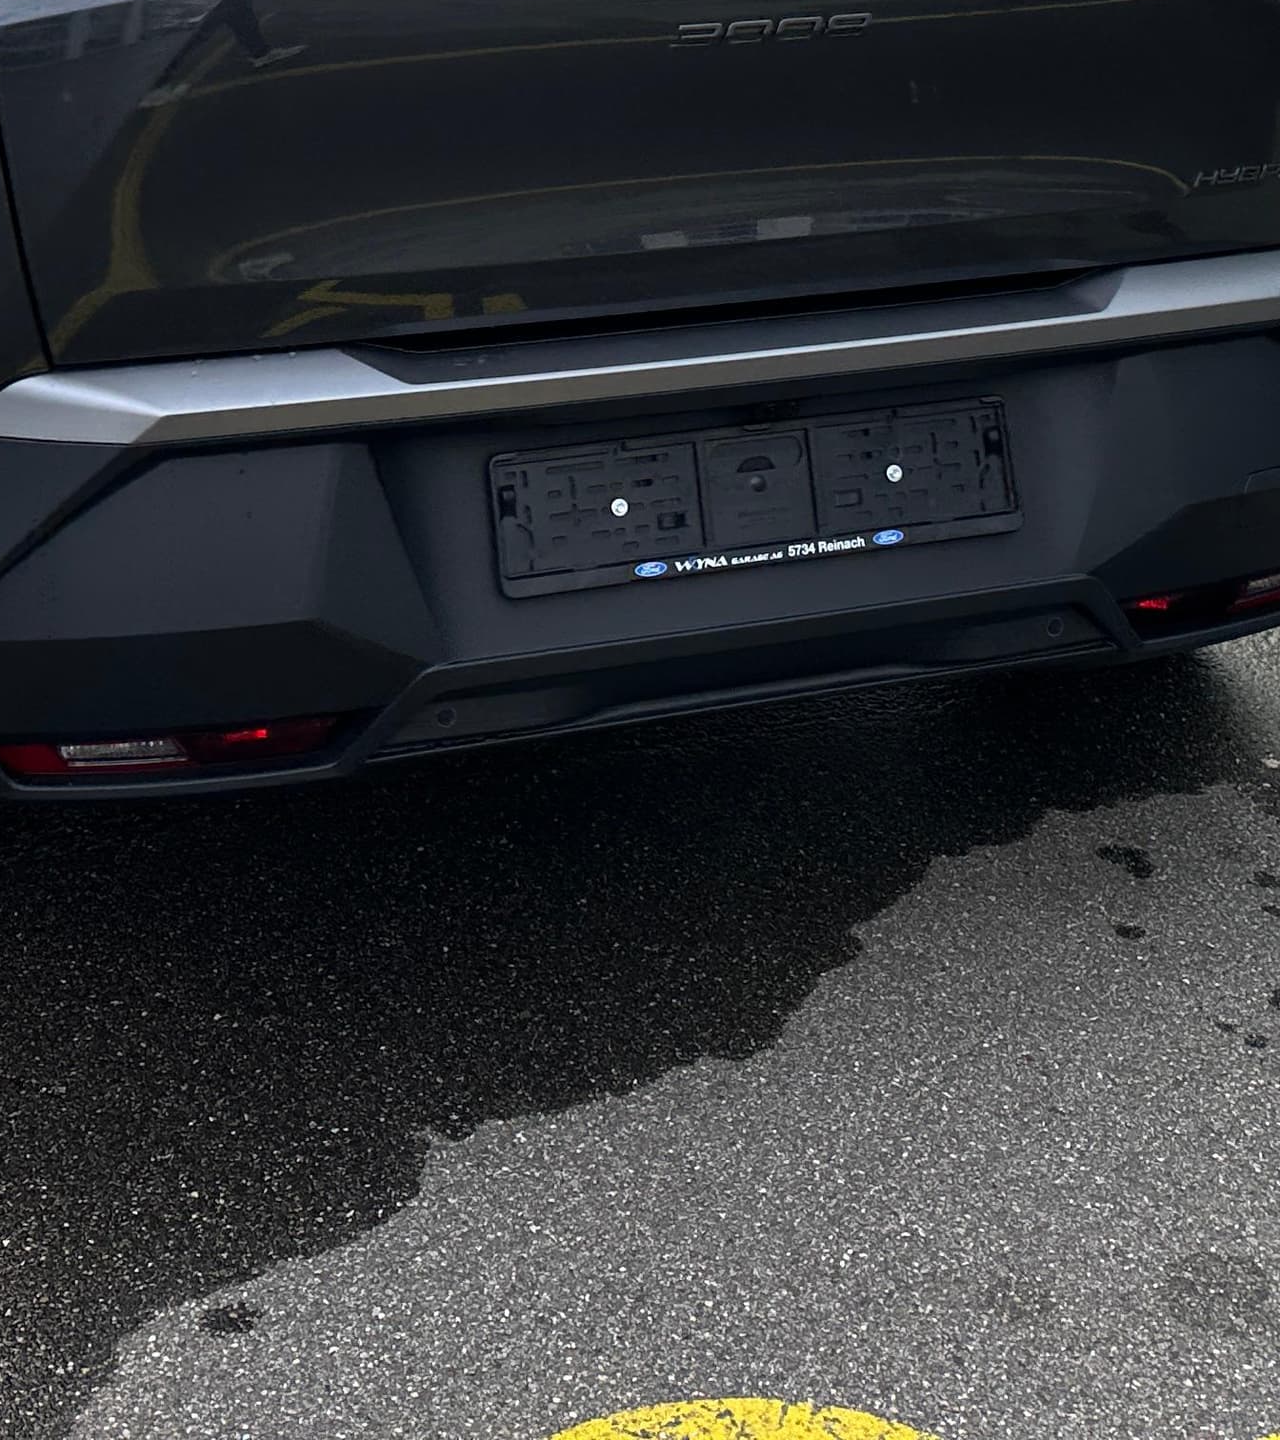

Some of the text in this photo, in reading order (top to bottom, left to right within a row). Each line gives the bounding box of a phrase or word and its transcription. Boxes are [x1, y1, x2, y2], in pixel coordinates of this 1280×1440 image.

[675, 555, 728, 572] WYNA
[788, 542, 816, 558] 5734
[818, 536, 865, 553] Reinach
